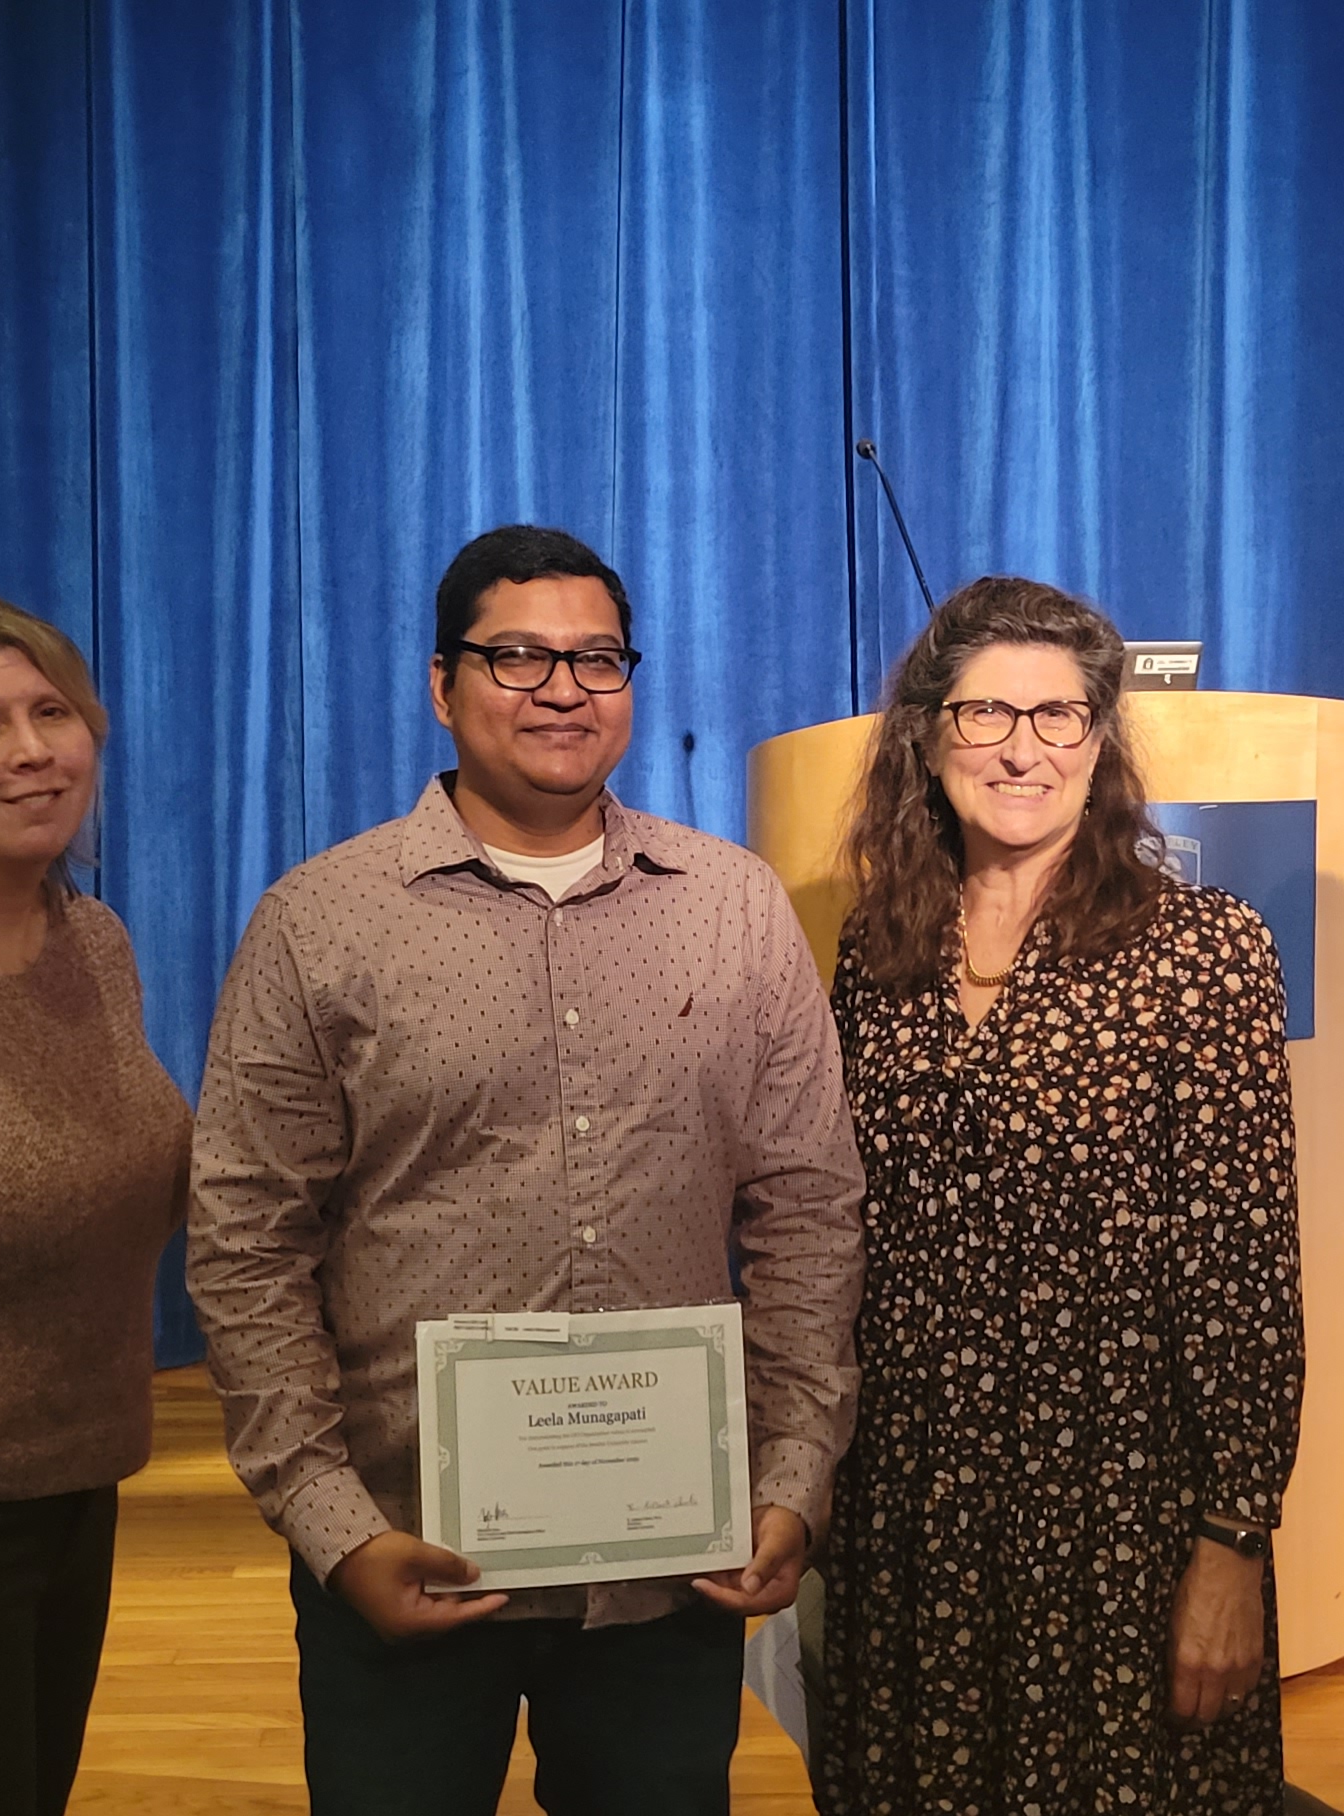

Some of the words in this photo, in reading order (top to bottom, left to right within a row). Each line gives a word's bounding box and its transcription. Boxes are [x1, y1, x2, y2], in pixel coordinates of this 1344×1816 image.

[511, 1376, 581, 1396] VALUE
[585, 1371, 659, 1392] AWARD
[528, 1412, 564, 1428] Leela
[567, 1406, 647, 1426] Munagapati
